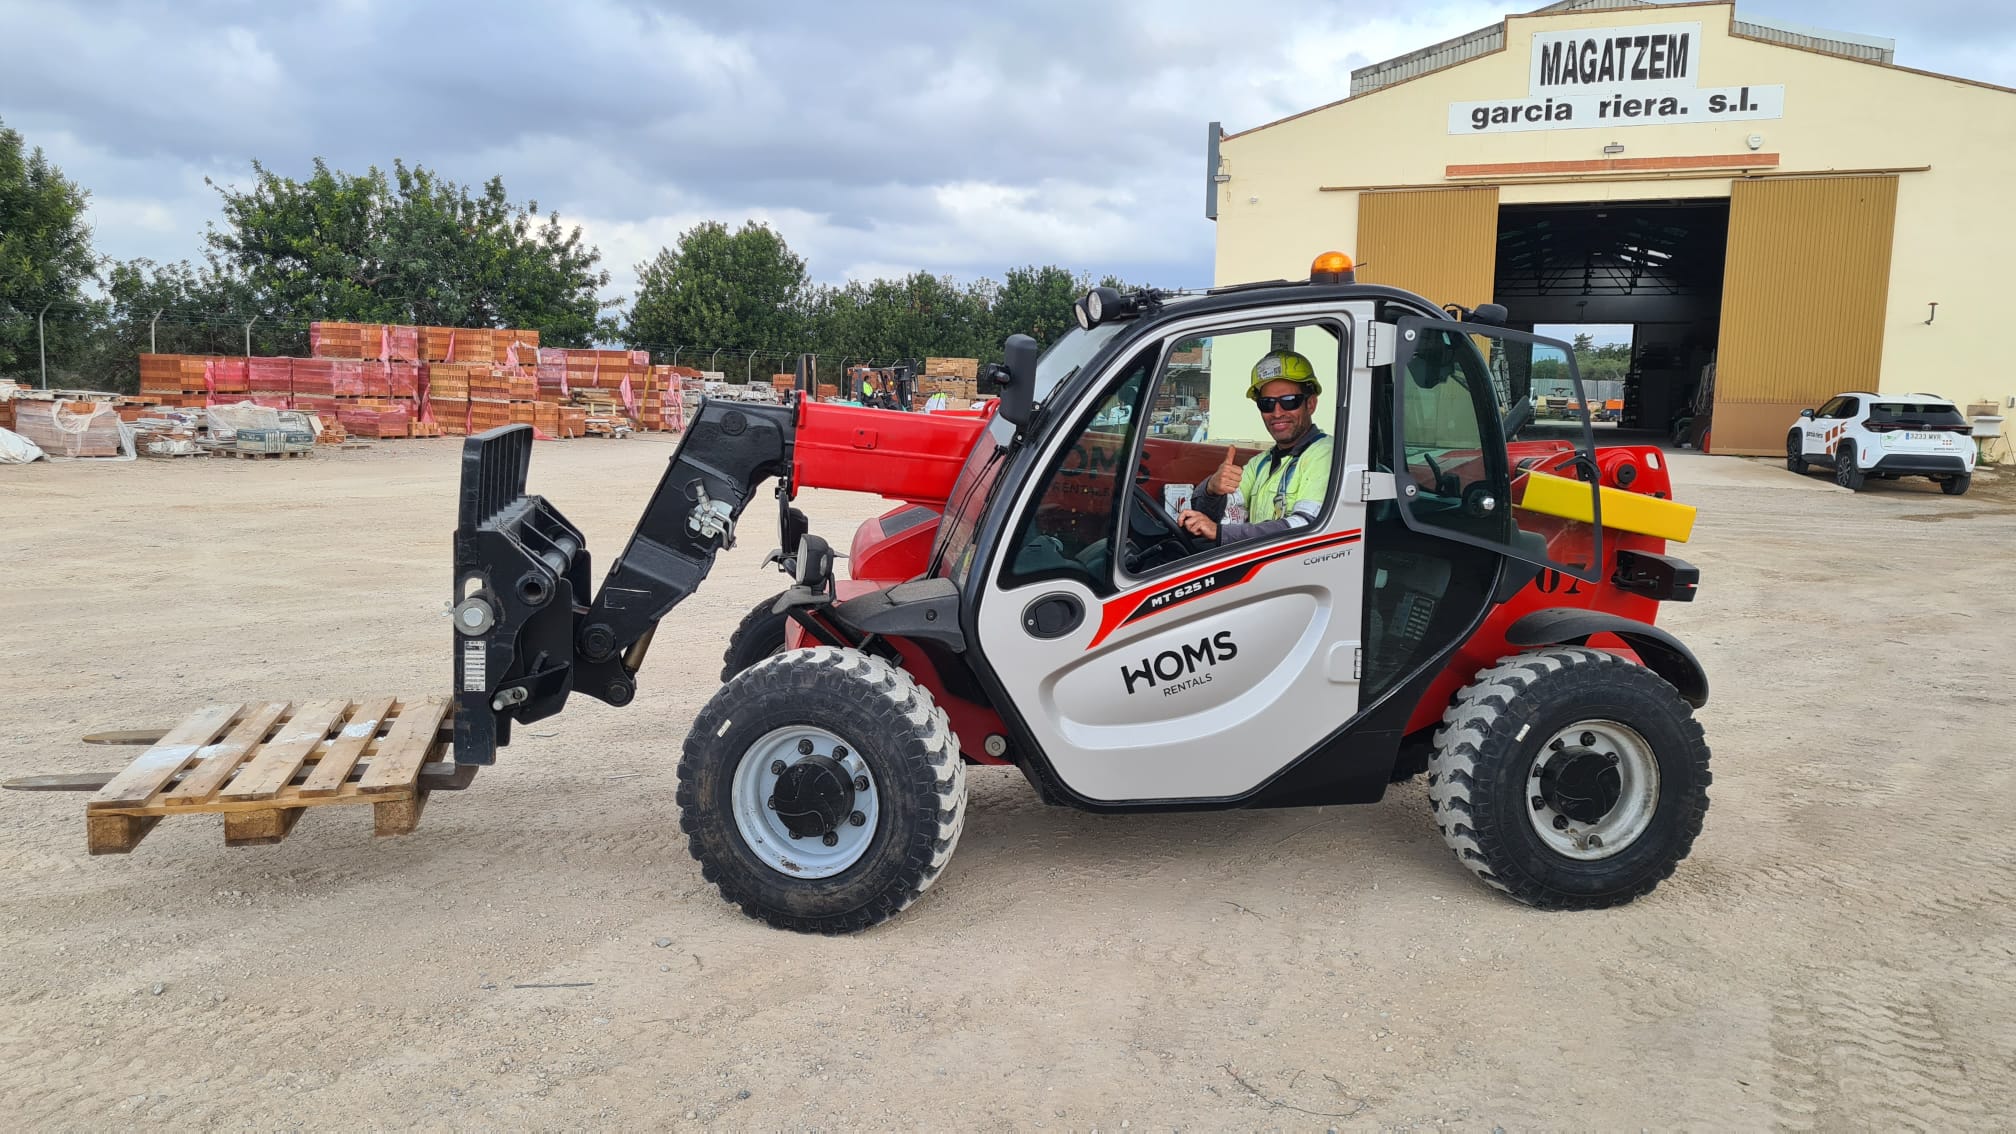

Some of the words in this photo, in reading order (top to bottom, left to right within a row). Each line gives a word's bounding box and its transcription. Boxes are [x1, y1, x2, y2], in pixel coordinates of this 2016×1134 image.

[1540, 33, 1689, 86] MAGATZEM
[1471, 98, 1573, 129] garcia
[1599, 94, 1688, 118] riera.
[1708, 87, 1758, 113] s.l.
[1058, 444, 1150, 485] OMS
[1304, 549, 1352, 565] COMFORT
[1151, 592, 1172, 607] MT
[1174, 582, 1202, 598] 625
[1205, 576, 1215, 587] H
[1121, 631, 1238, 695] HOMS
[1163, 673, 1213, 697] RENTALS
